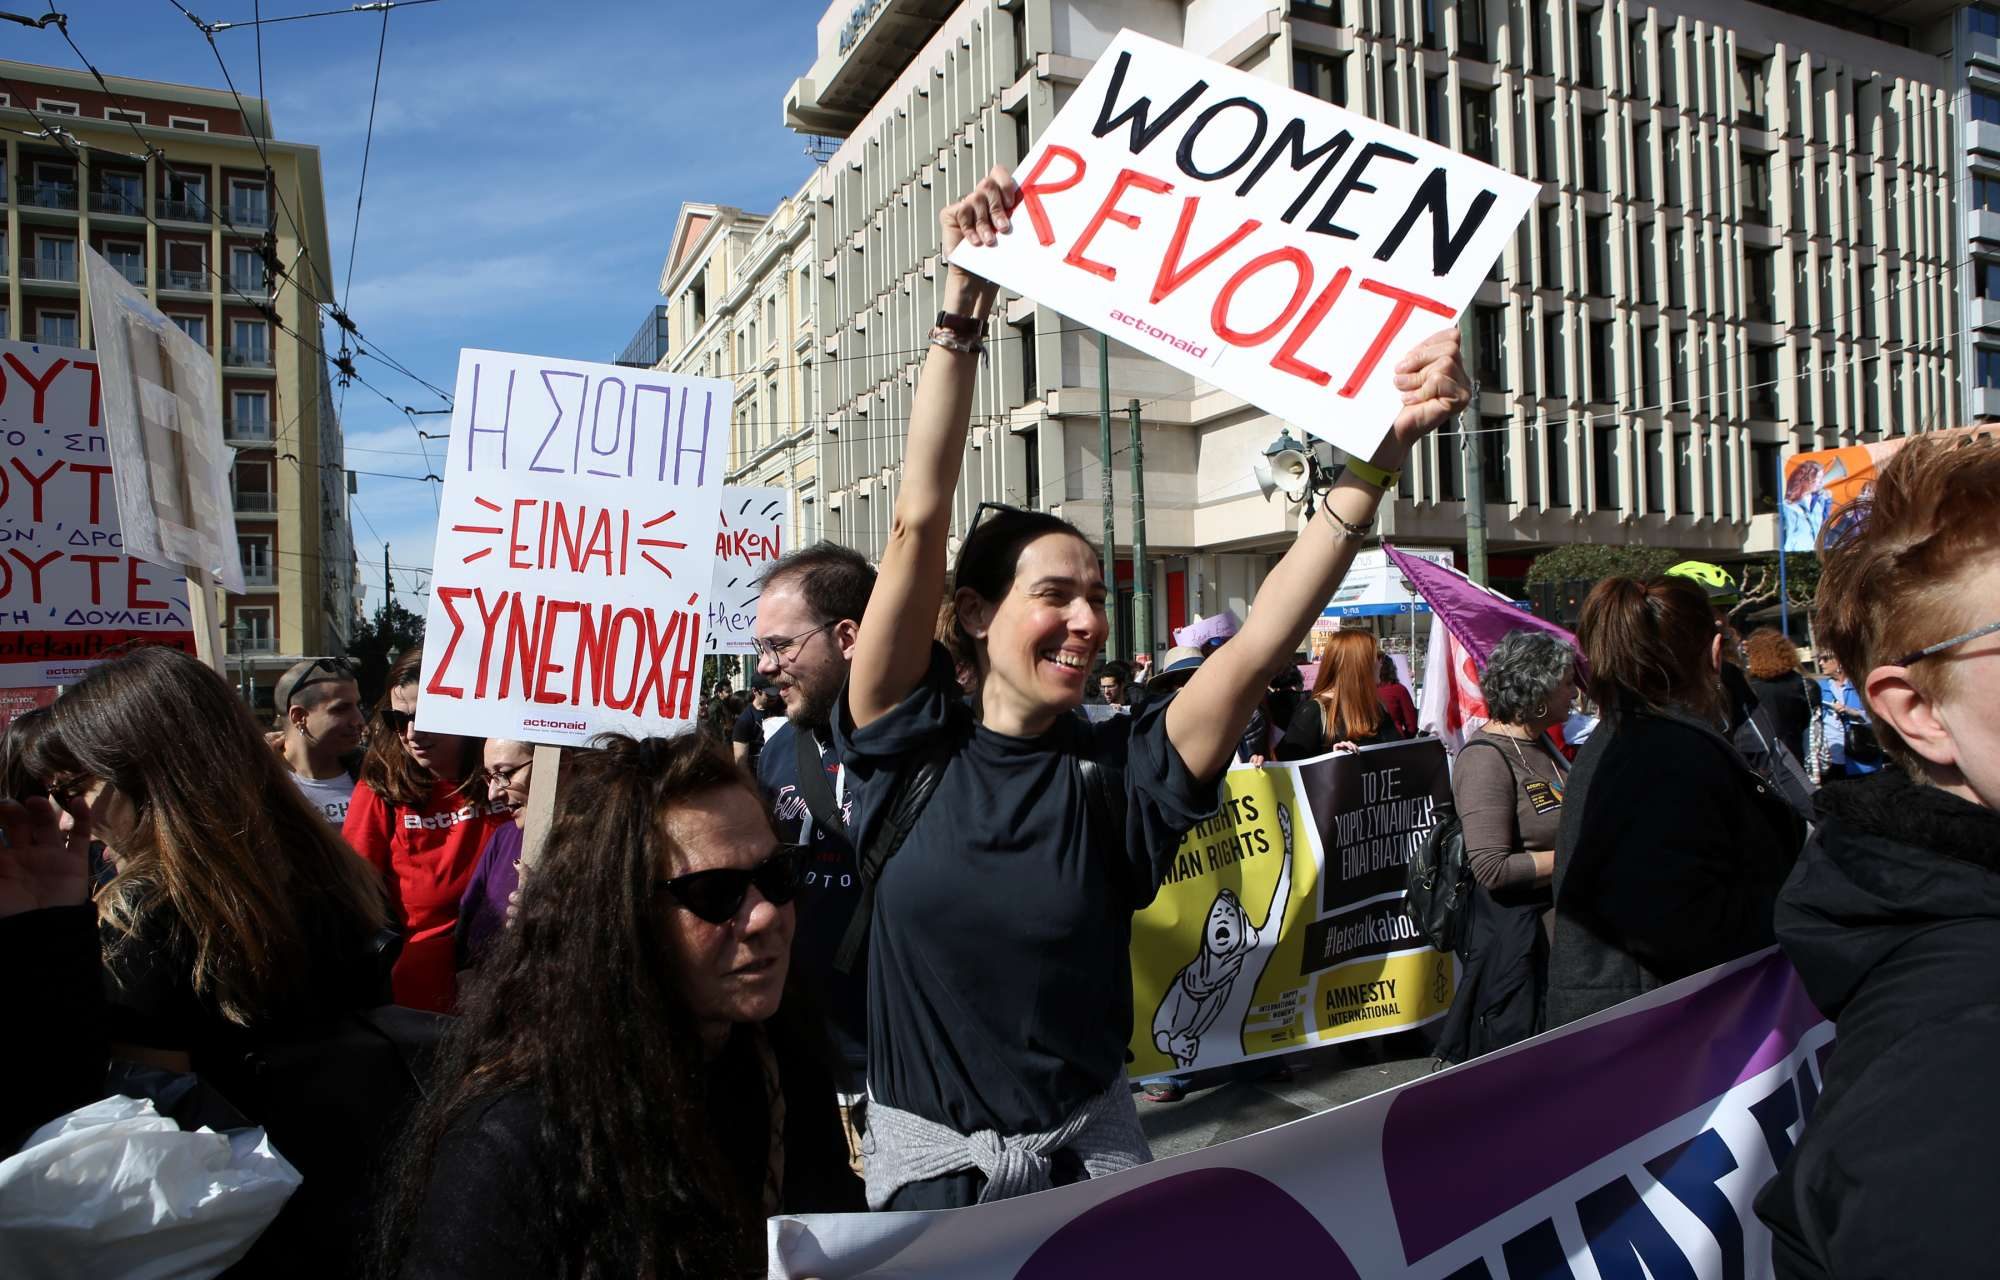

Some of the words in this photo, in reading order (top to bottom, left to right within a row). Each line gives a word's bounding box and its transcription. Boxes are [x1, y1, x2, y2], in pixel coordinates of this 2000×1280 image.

[1091, 51, 1497, 276] WOMEN
[1020, 144, 1457, 398] REVOLT
[468, 363, 515, 471] Η
[529, 369, 713, 487] ΣΙΩΠΗ
[509, 499, 629, 576] ΕΙΝΑΙ
[65, 608, 184, 626] ΔΟΥΛΕΙΑ
[1361, 772, 1377, 805] ΤΟ
[1206, 829, 1269, 872] RIGHTS
[1342, 842, 1369, 880] ΕΙΝΑΙ
[1326, 979, 1396, 1011] AMNESTY
[1328, 1002, 1400, 1027] INTERNATIONAL
